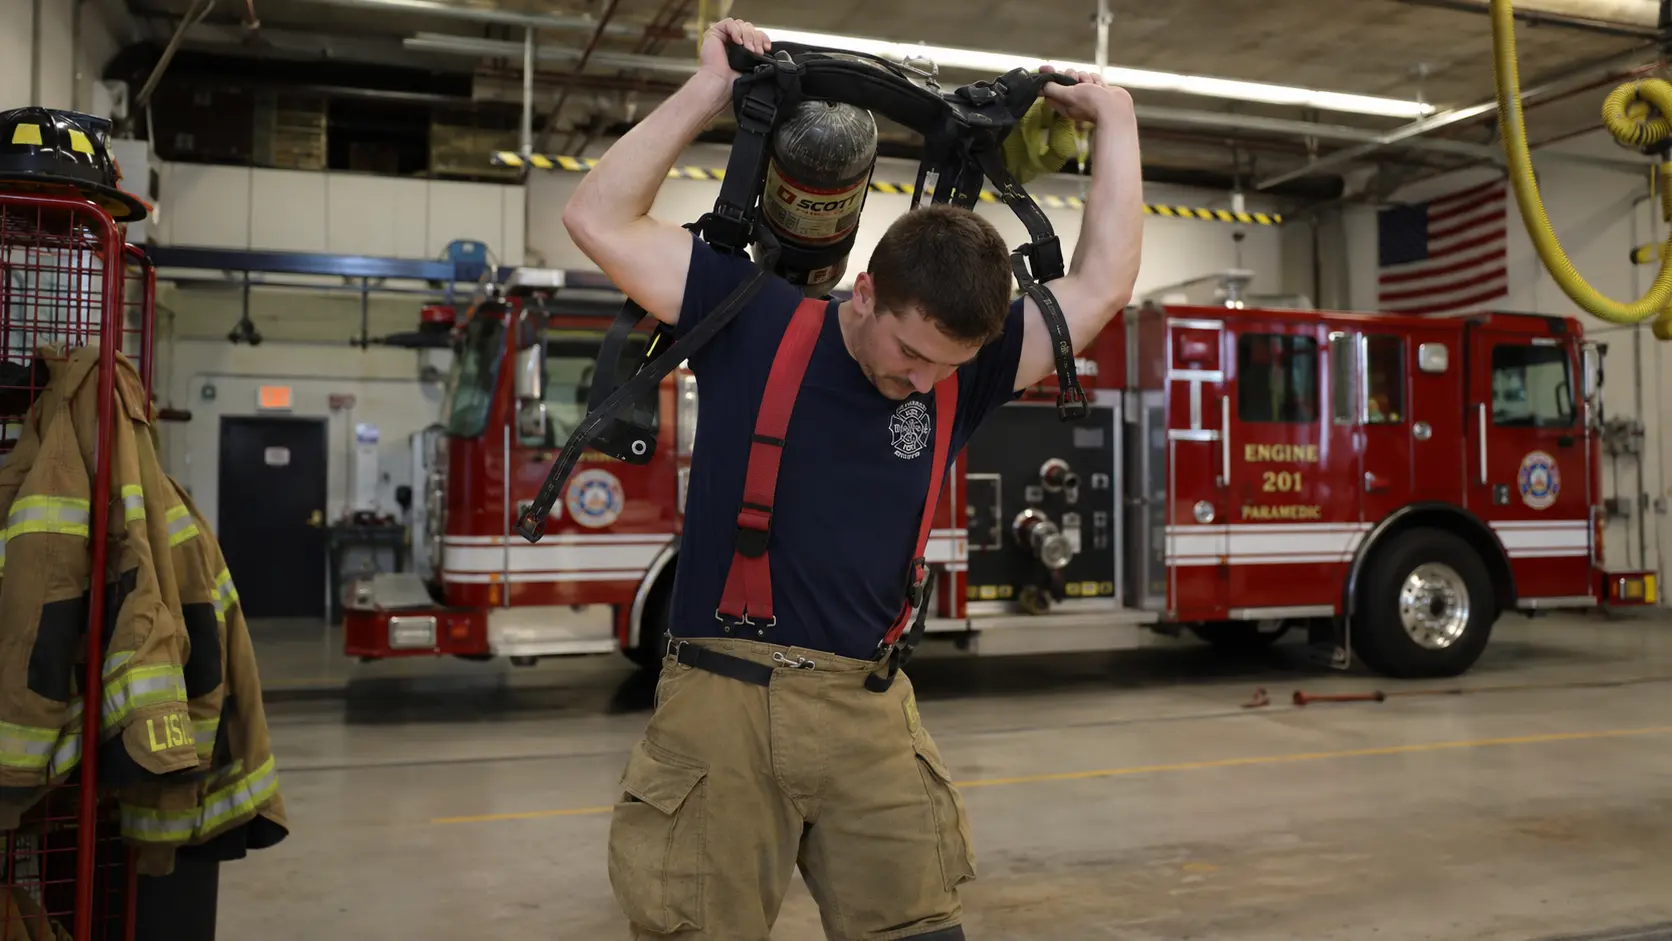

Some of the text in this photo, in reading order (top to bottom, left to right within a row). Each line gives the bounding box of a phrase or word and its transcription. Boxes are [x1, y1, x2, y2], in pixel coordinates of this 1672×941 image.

[796, 192, 859, 212] SCOTT
[1244, 444, 1318, 462] ENGINE
[1262, 470, 1302, 492] 201
[1241, 504, 1321, 520] PARAMEDIC
